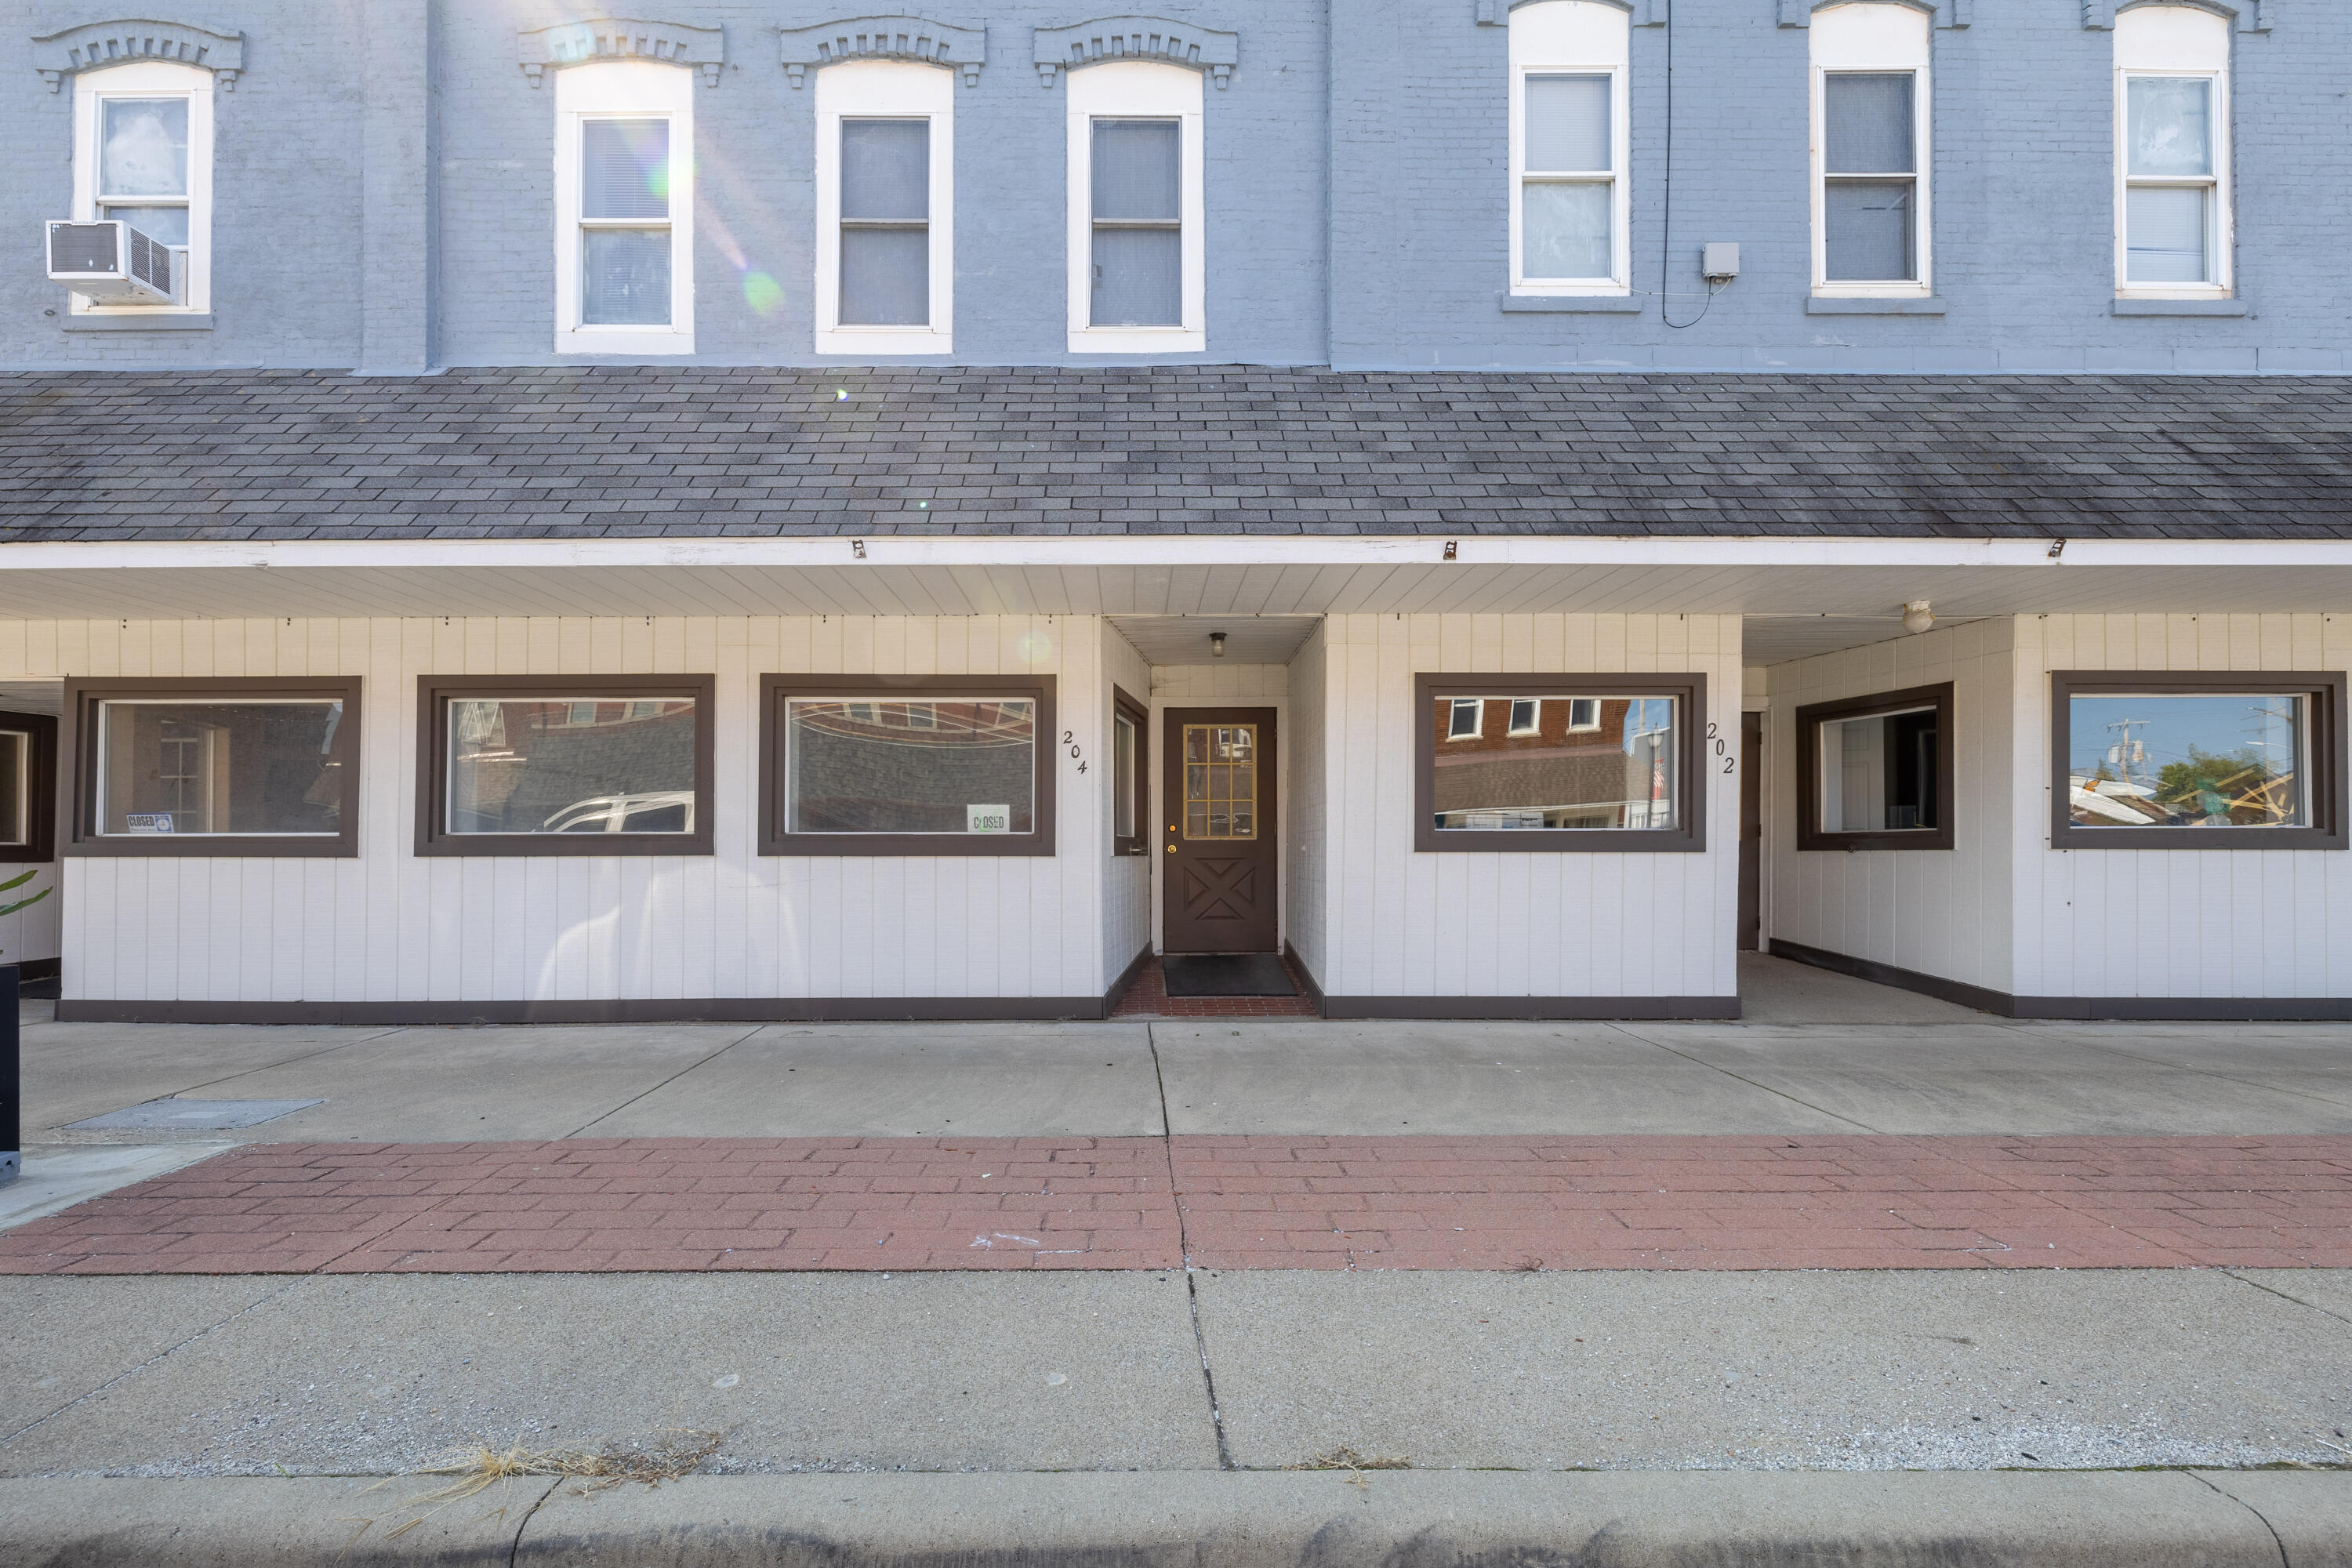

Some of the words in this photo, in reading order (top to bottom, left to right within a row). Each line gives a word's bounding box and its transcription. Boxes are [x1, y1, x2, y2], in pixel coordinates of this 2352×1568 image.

[1063, 730, 1087, 775] 204
[1707, 722, 1734, 774] 202
[128, 815, 155, 826] CLOSED
